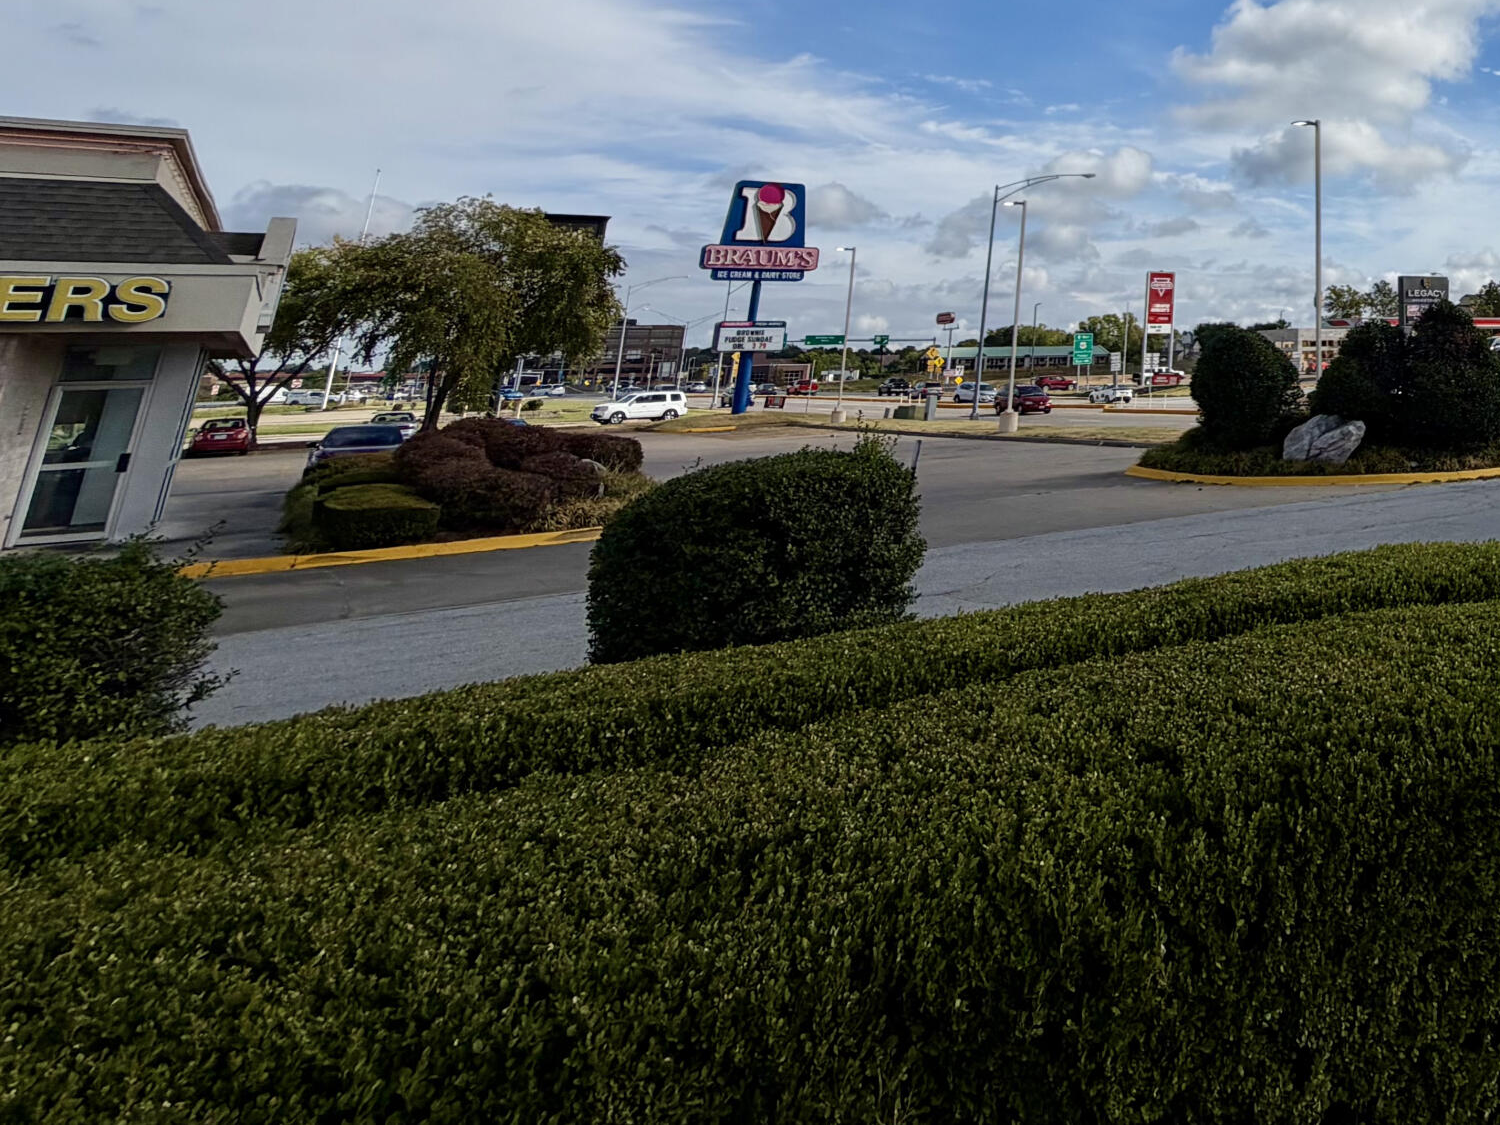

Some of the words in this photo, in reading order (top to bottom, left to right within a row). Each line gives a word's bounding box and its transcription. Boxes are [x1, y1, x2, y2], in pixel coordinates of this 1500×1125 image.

[707, 248, 814, 267] BRAUM'S
[0, 275, 170, 323] ERS
[1407, 289, 1446, 297] LEGACY
